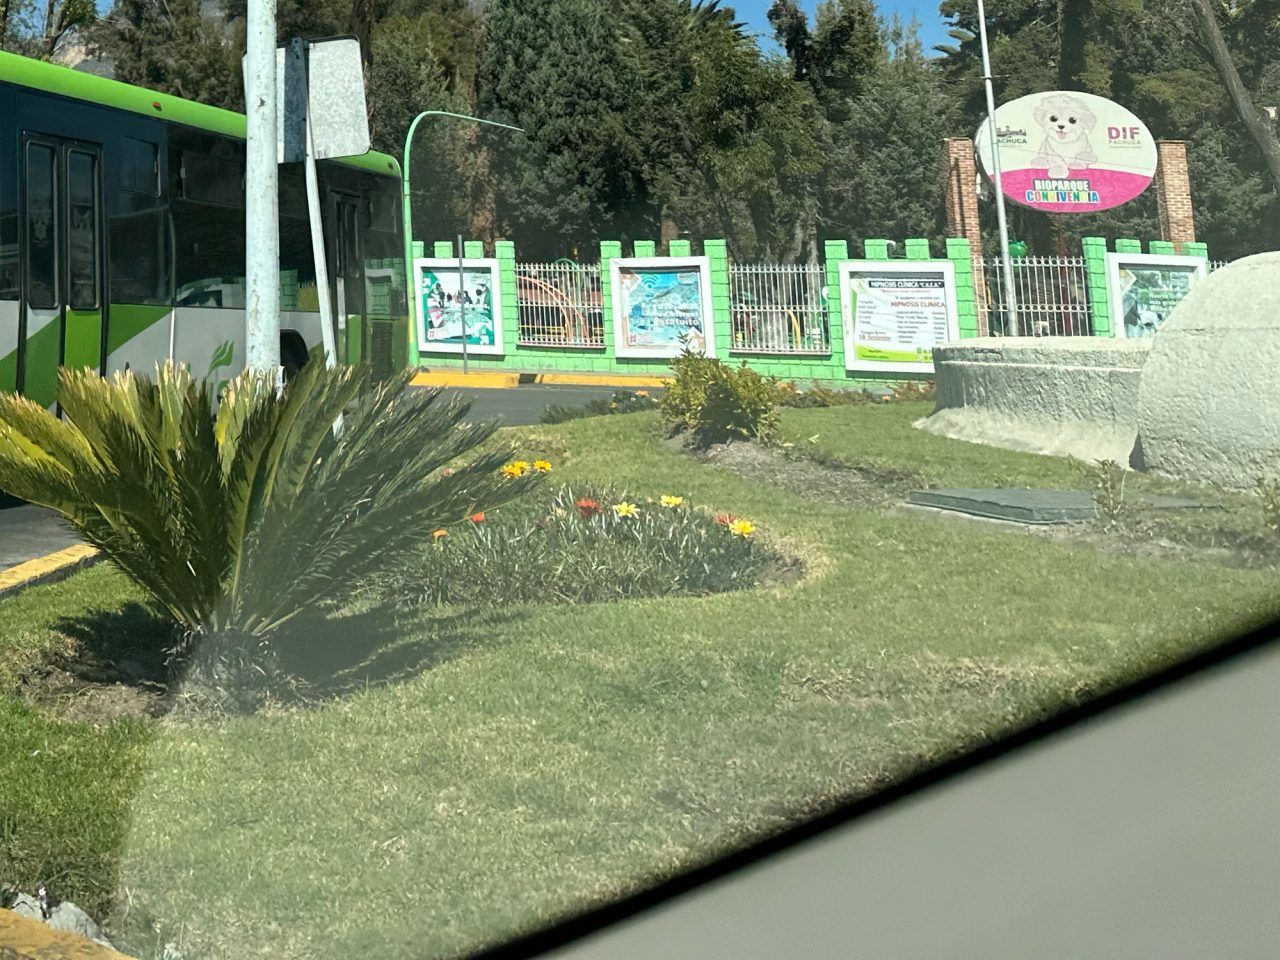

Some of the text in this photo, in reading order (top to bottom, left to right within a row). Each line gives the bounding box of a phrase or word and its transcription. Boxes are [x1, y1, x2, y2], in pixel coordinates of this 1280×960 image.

[1107, 126, 1140, 140] DIF
[1034, 180, 1089, 191] BIOPARQUE
[1026, 190, 1099, 203] CONVIVENCIA
